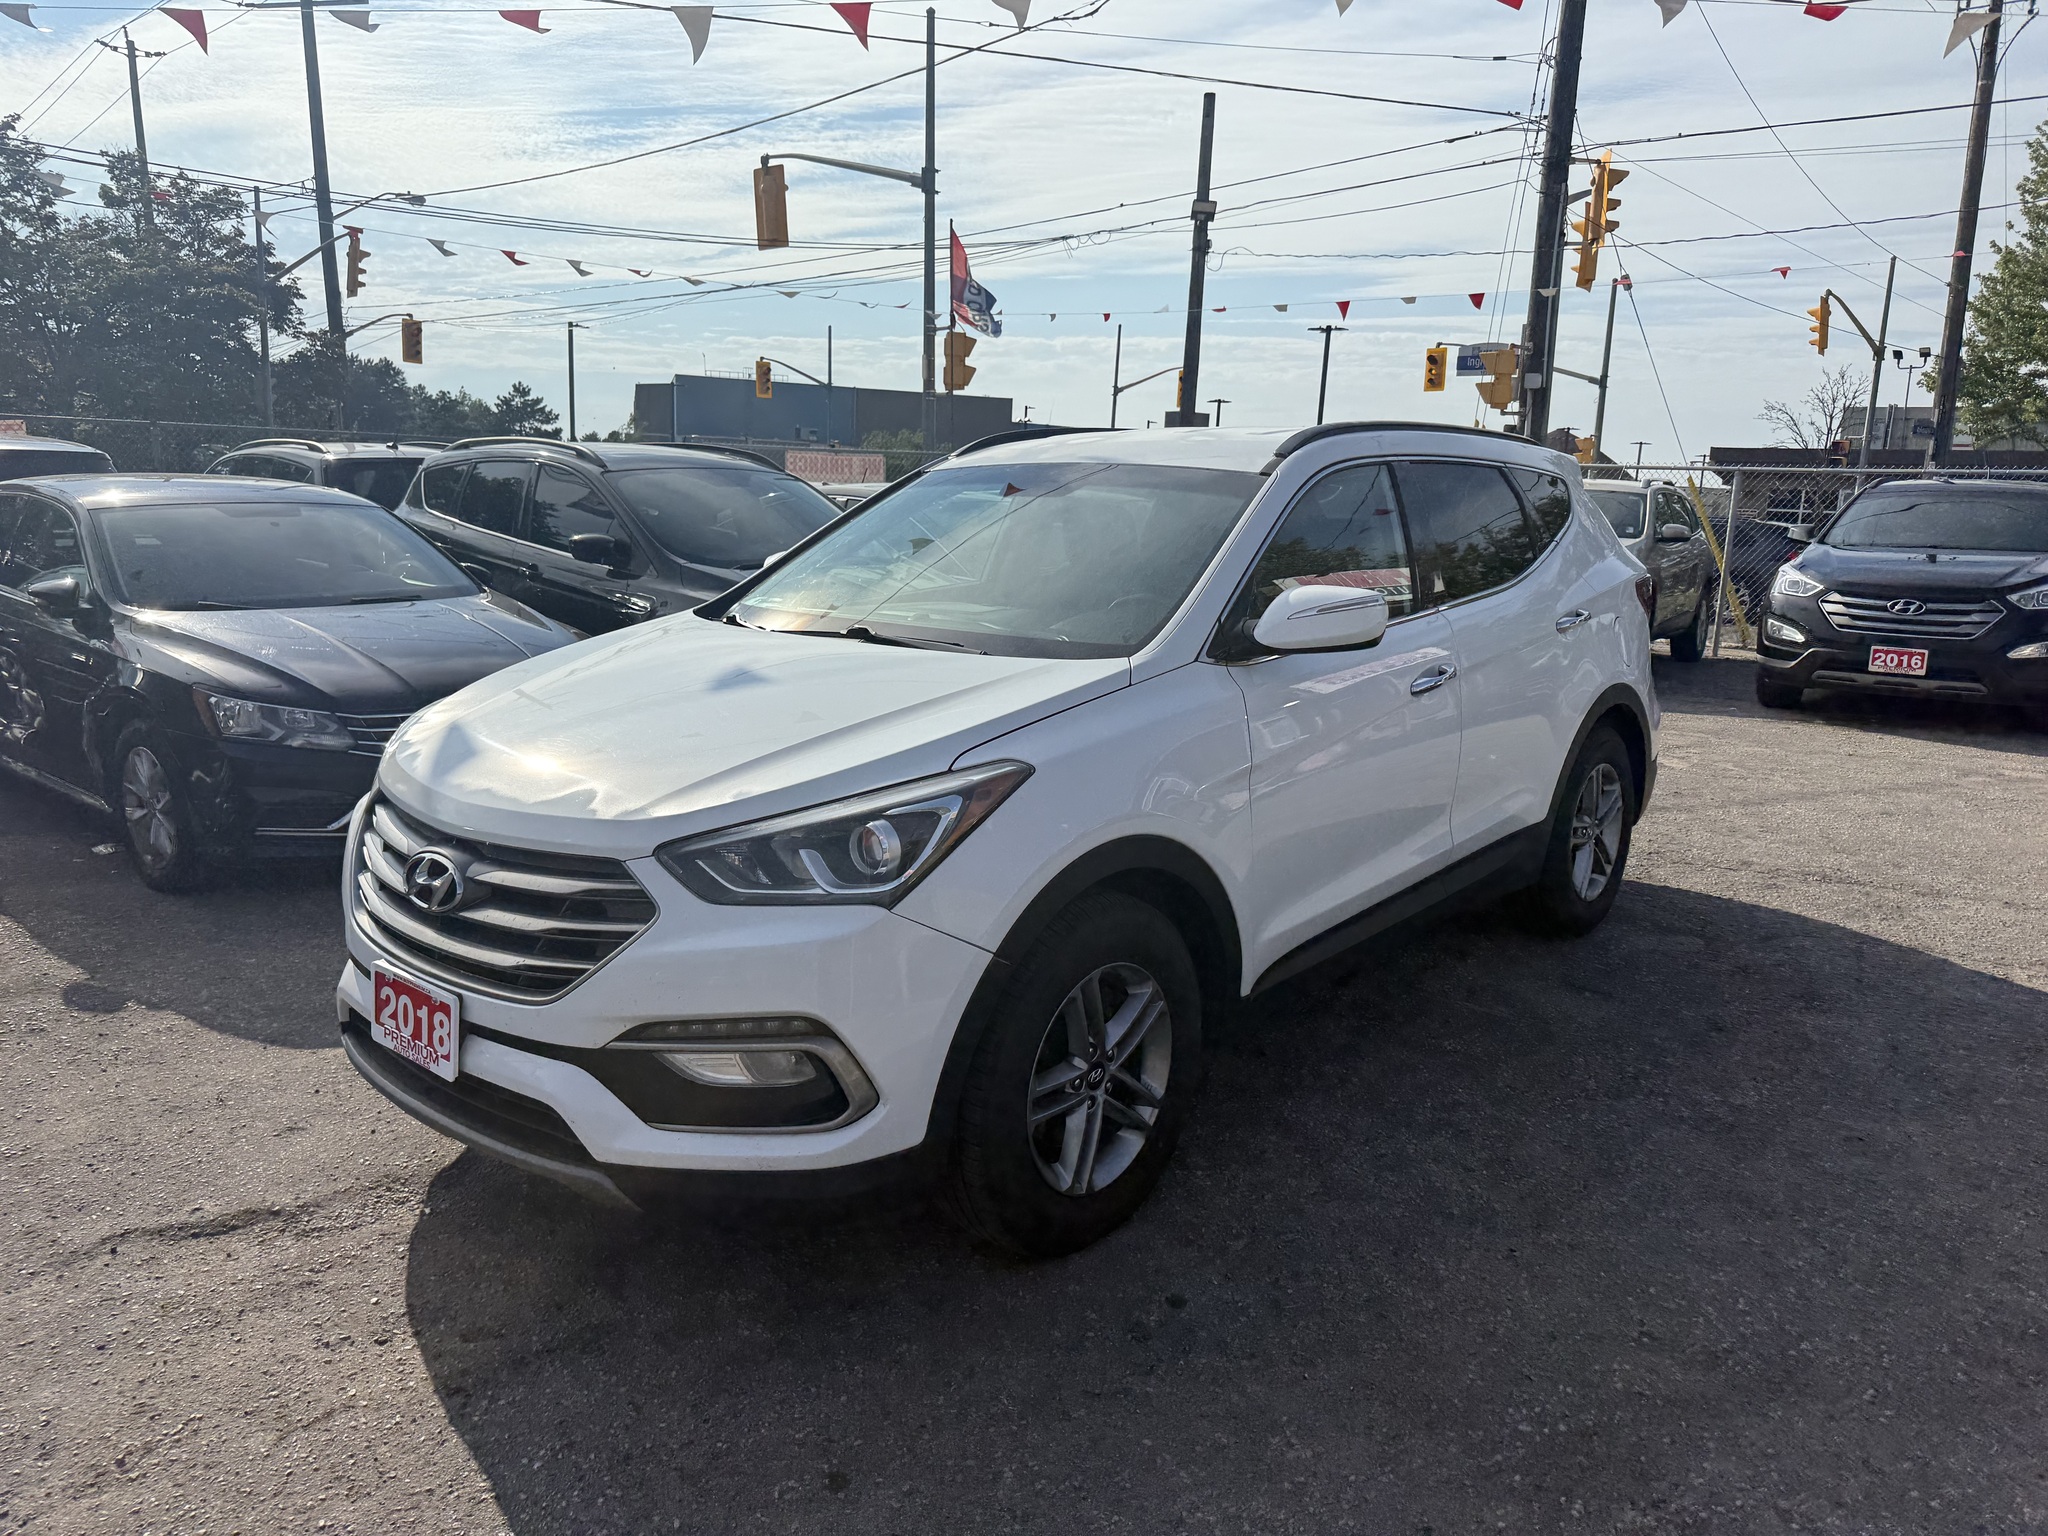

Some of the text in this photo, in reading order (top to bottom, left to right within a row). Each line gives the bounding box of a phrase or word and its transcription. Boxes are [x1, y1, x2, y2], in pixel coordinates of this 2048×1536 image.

[1467, 357, 1483, 368] Ing
[1873, 652, 1922, 669] 2016
[380, 986, 451, 1056] 2018
[383, 1024, 440, 1067] PREMIUM
[393, 1044, 431, 1070] AUTO SALES
